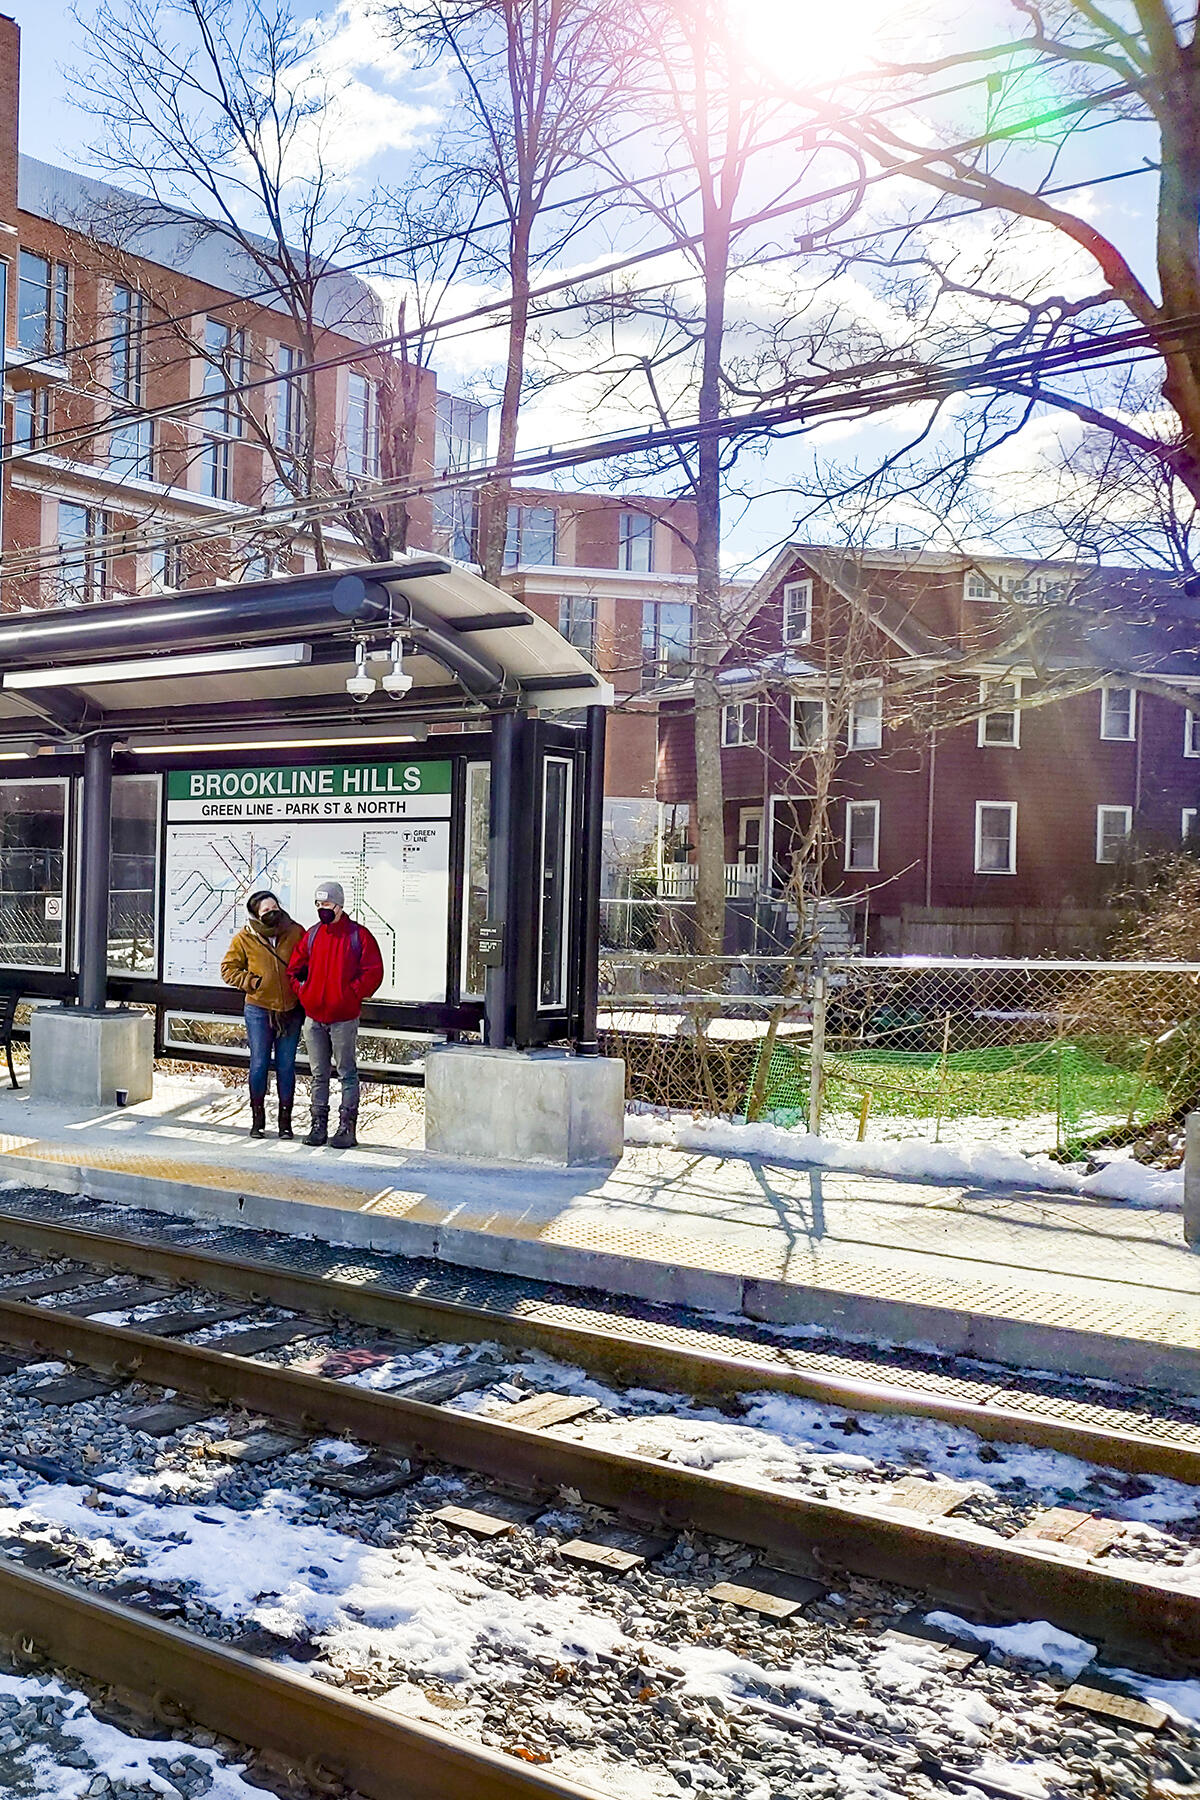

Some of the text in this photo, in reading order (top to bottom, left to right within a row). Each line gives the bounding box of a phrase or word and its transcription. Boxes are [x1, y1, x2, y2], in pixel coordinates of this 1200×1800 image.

[190, 766, 422, 797] BROOKLINE HILLS
[201, 804, 243, 816] GREEN
[246, 803, 274, 815] LINE
[285, 803, 320, 815] PARK
[323, 802, 341, 813] ST
[344, 802, 353, 814] &
[356, 801, 406, 814] NORTH
